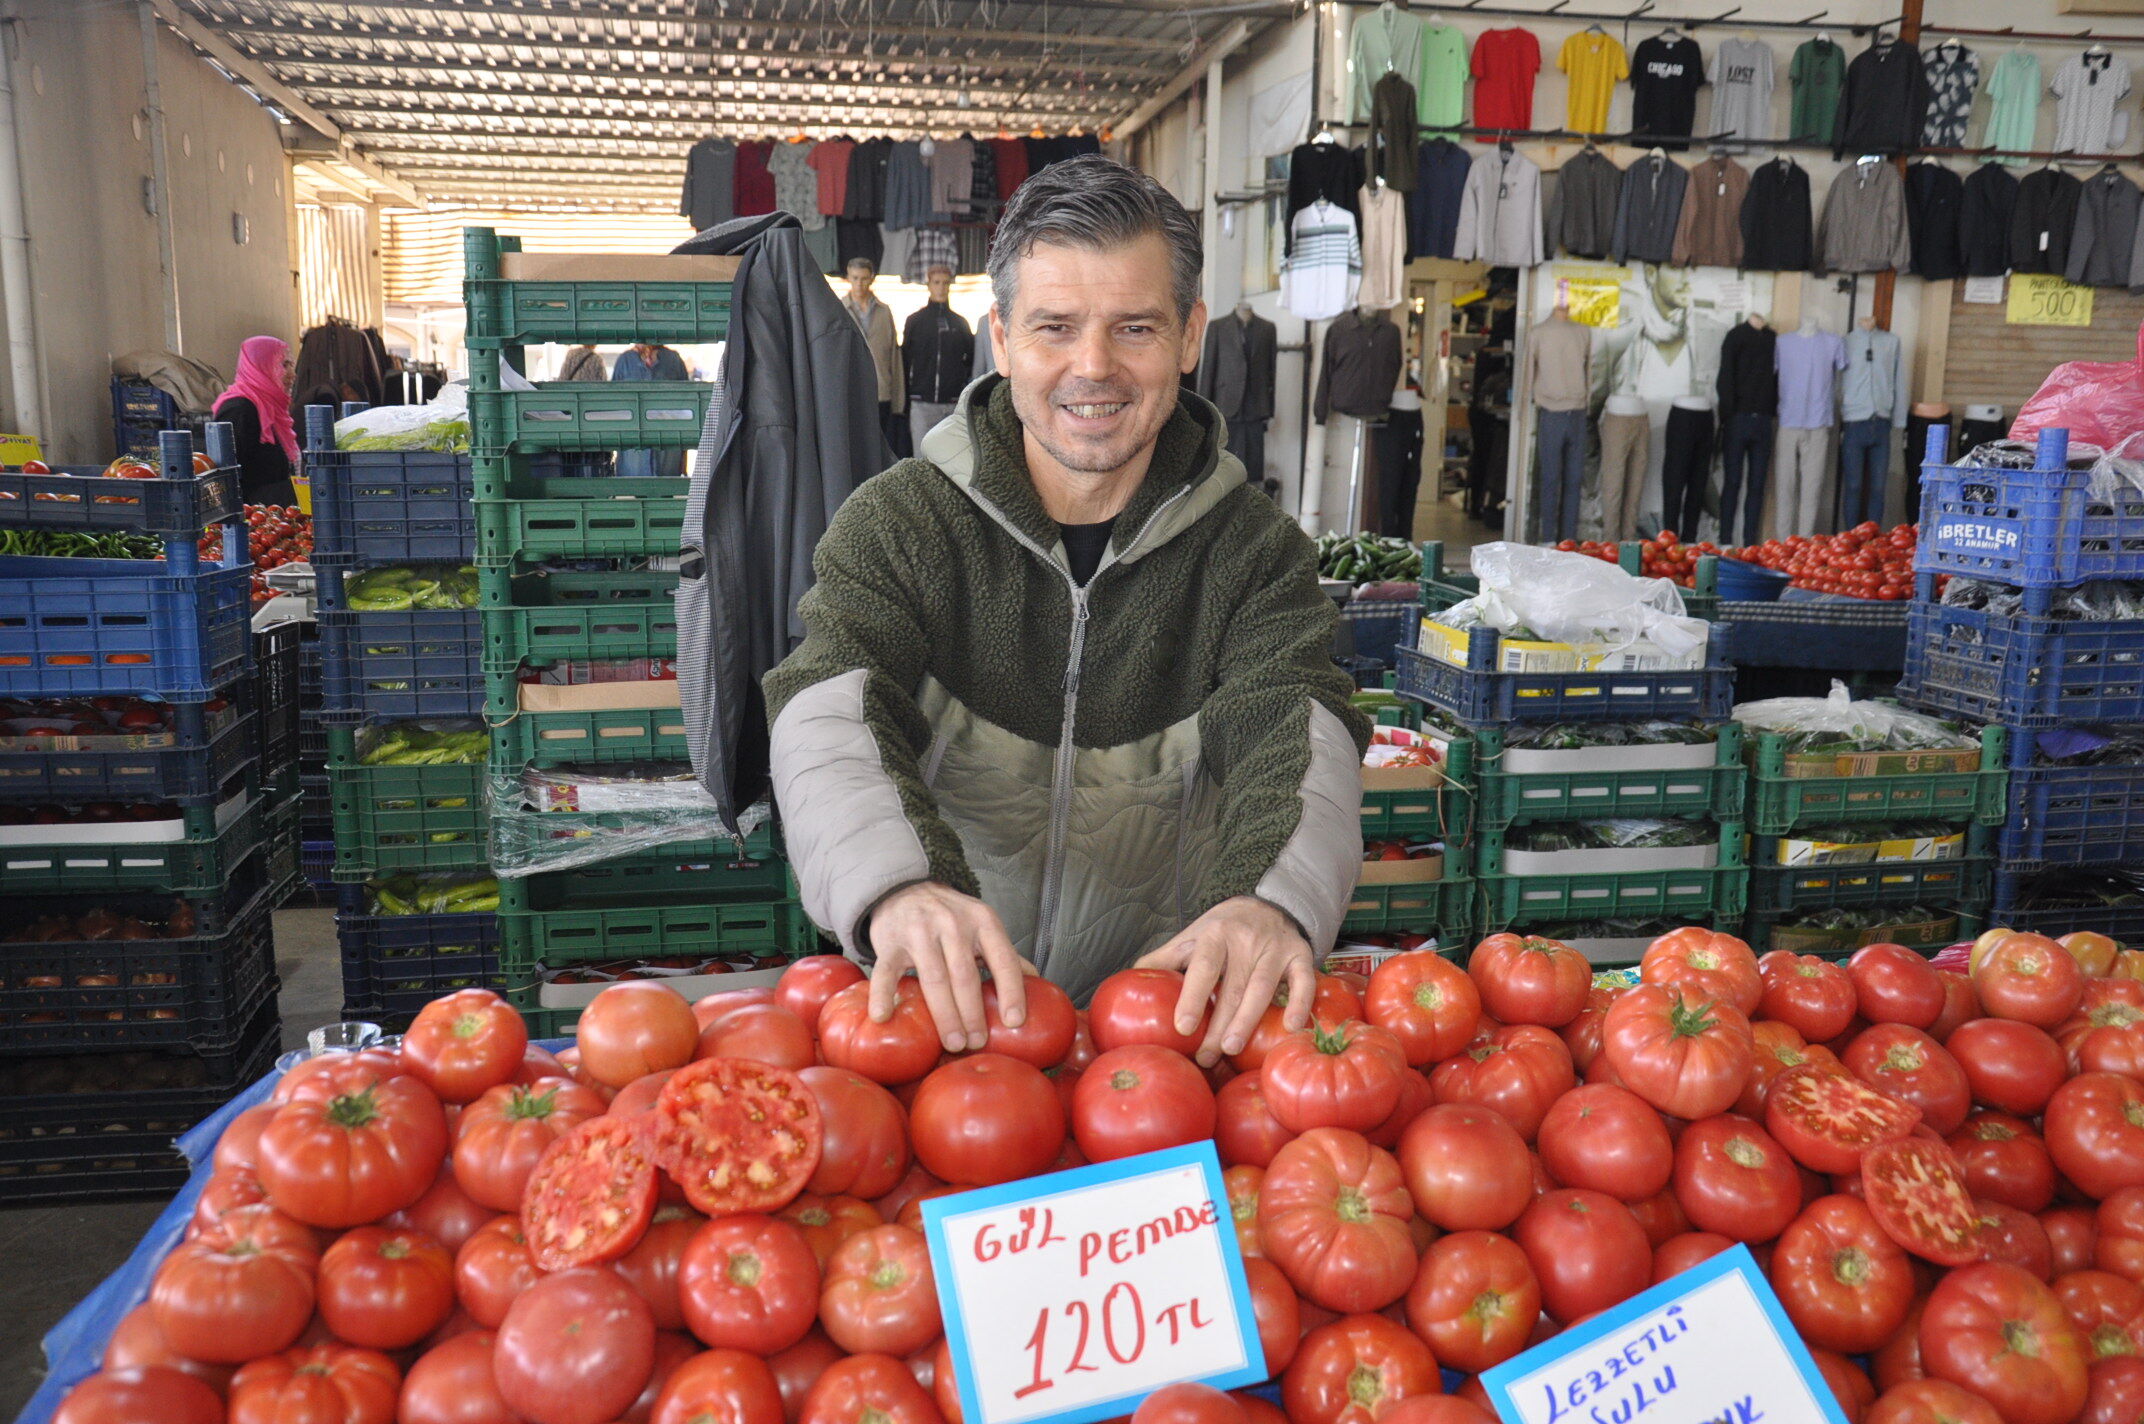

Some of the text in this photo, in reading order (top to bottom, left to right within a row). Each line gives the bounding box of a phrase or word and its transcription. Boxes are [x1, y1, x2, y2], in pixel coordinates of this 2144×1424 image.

[2031, 290, 2077, 317] 500
[1013, 1281, 1214, 1399] 120 TL
[1591, 1364, 1678, 1424] SULU
